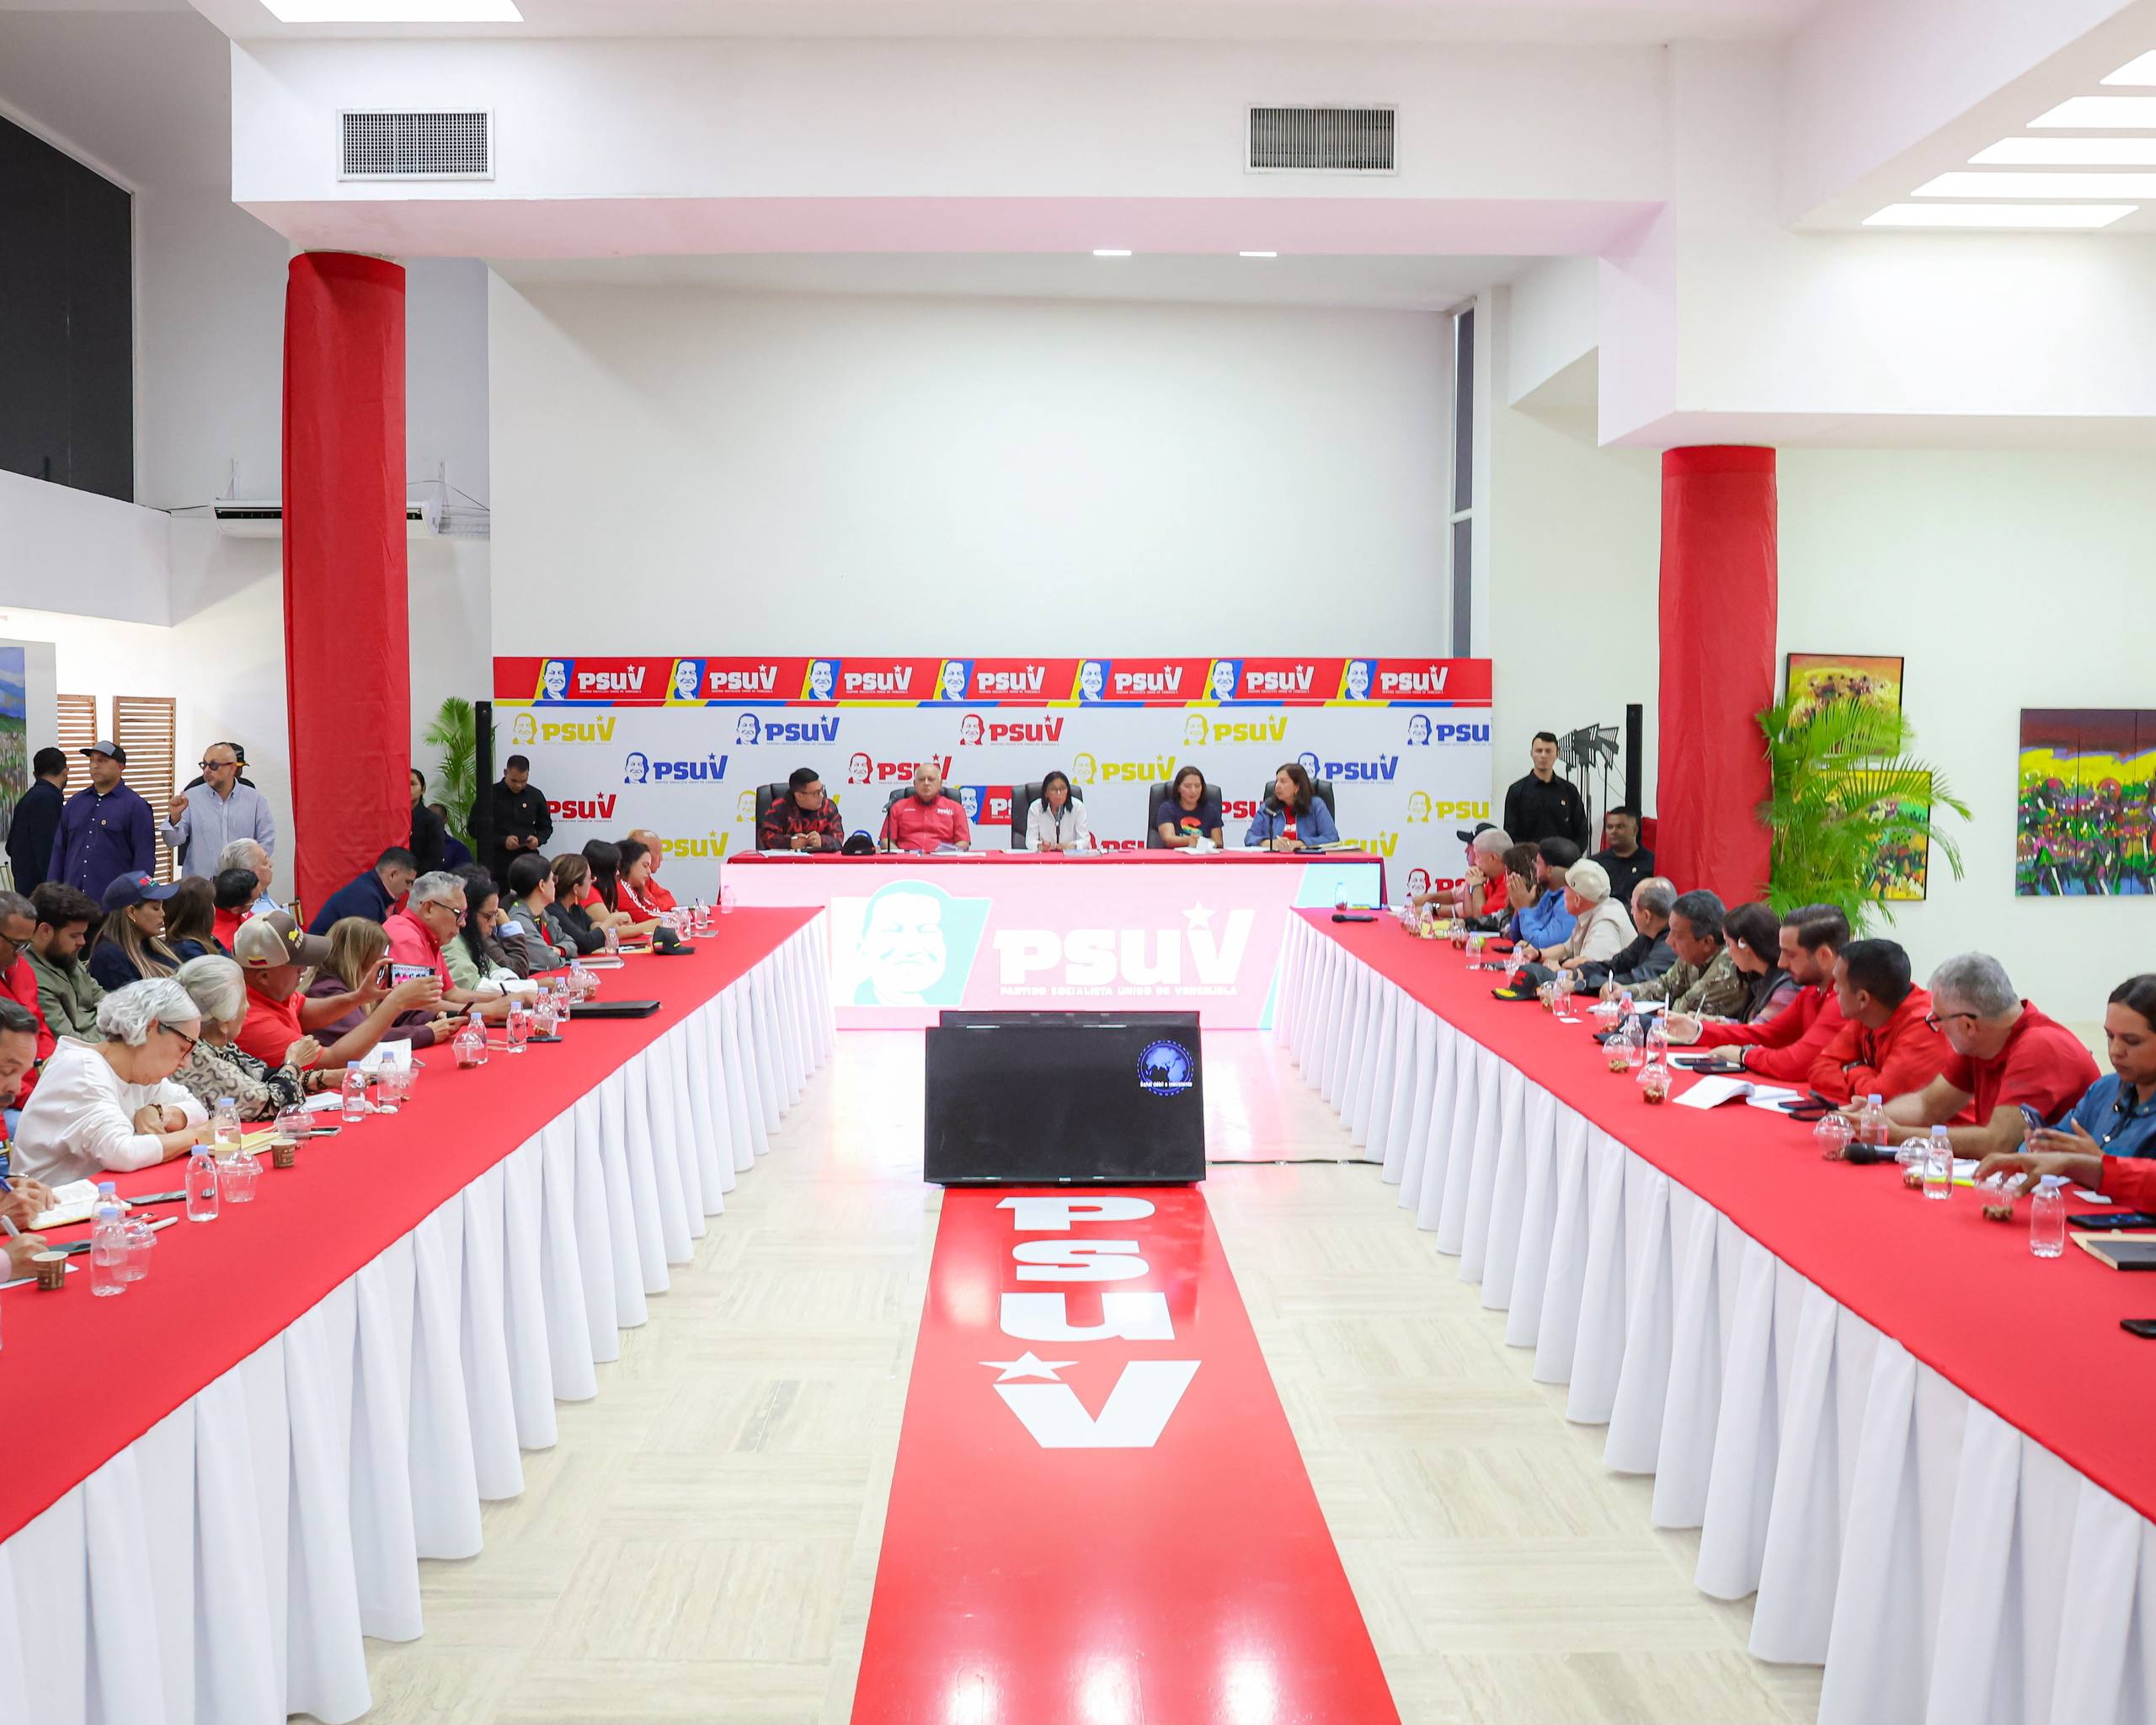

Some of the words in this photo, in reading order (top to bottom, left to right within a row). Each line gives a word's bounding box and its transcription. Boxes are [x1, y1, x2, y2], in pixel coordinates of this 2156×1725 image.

[1436, 724, 1489, 741] PSU
[877, 756, 952, 780] PSV
[1436, 802, 1489, 819] PSU
[1000, 986, 1046, 996] PARTIDO
[1051, 986, 1113, 996] SOCIALISTA
[1118, 986, 1152, 996] UNIDO
[1156, 986, 1170, 996] DE
[1174, 986, 1238, 996] VENEZUELA
